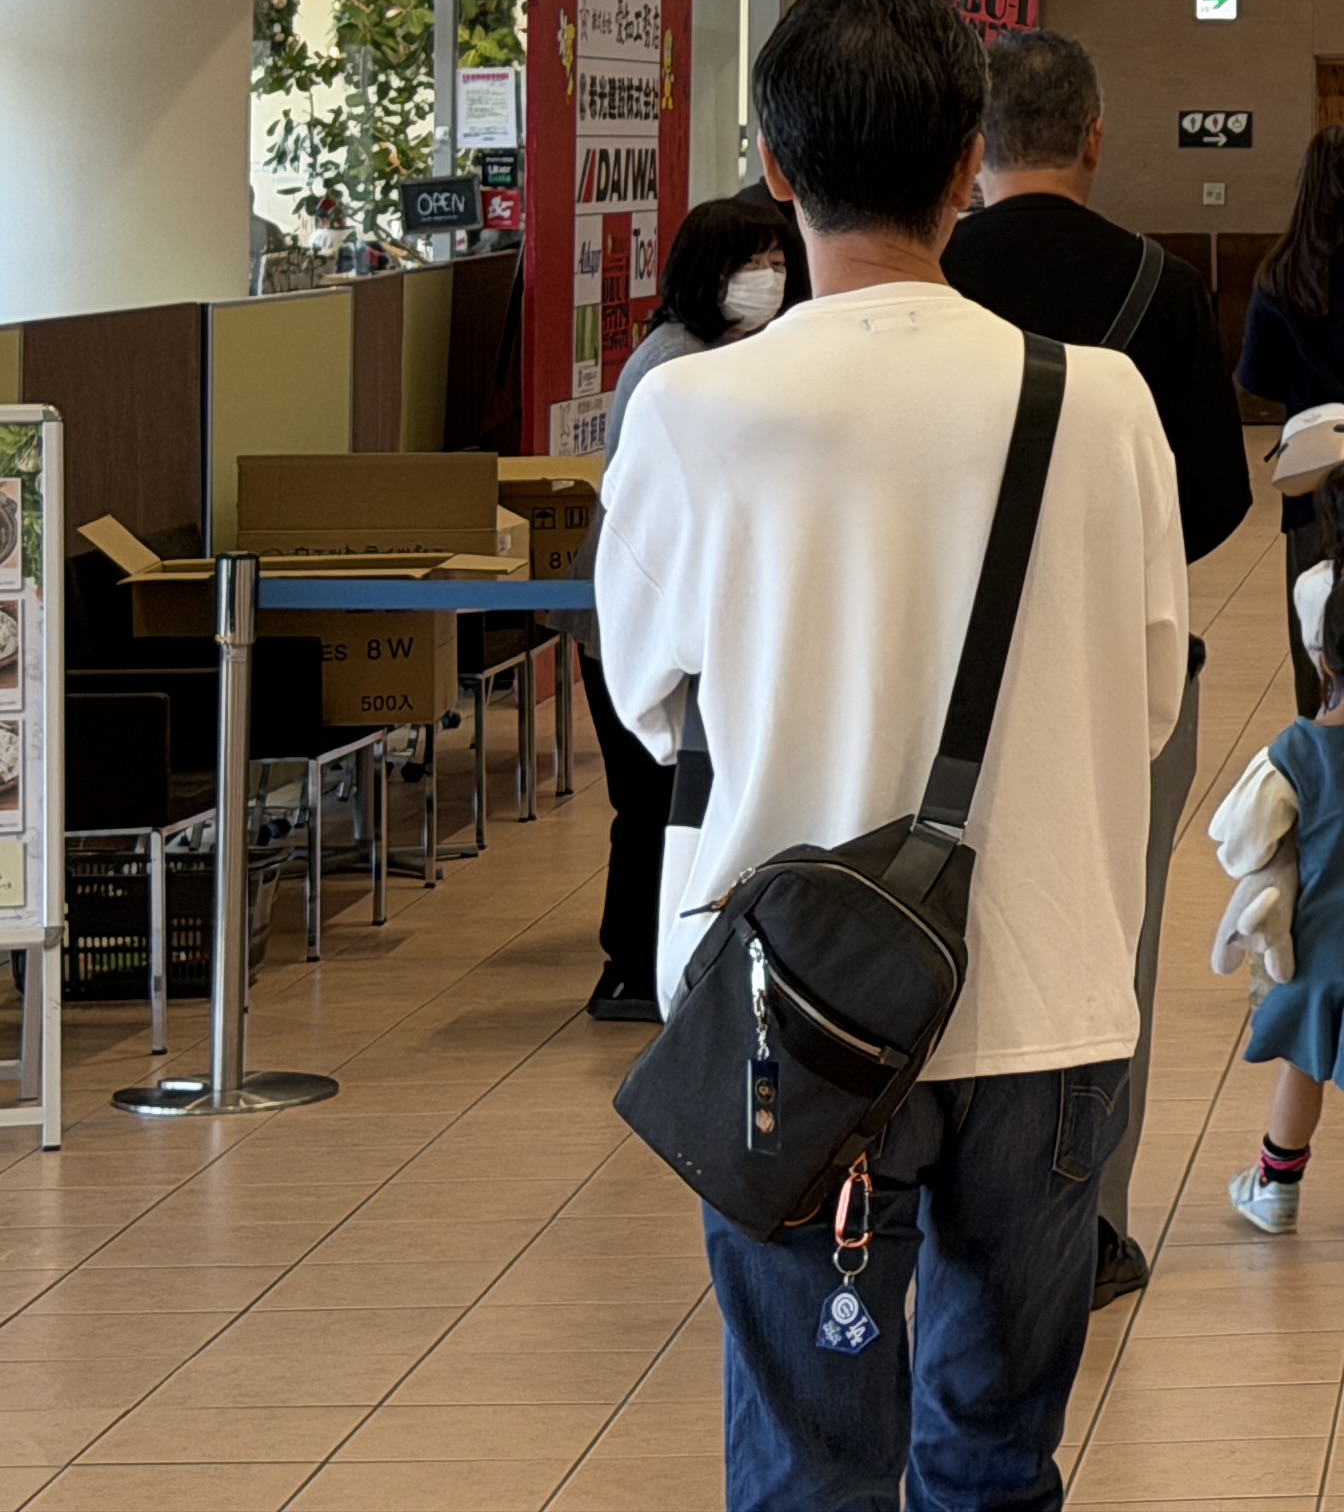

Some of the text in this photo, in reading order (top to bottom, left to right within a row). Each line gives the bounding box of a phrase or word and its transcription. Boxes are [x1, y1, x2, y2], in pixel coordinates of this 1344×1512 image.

[595, 148, 658, 202] DAIWA
[417, 192, 466, 215] OPEN
[361, 694, 414, 712] 500入
